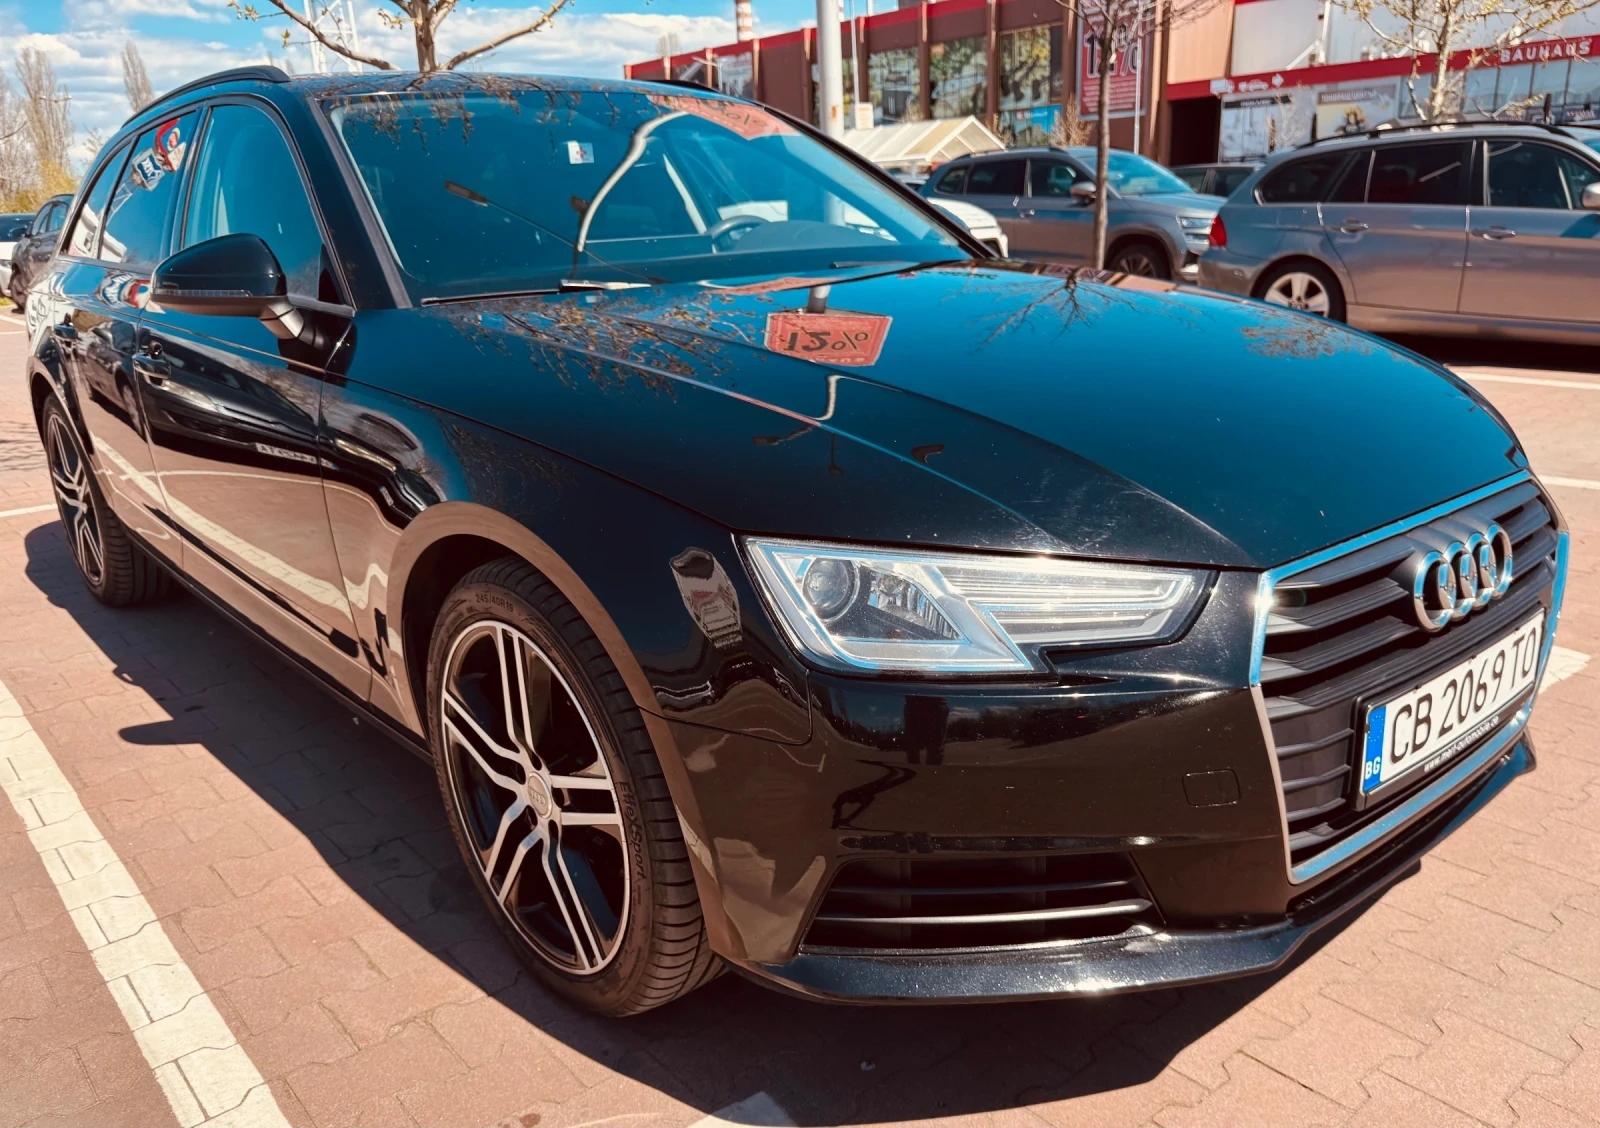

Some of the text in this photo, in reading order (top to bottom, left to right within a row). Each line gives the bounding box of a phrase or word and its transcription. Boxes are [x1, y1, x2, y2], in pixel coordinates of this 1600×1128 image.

[1501, 40, 1590, 63] BAUHAUS
[475, 593, 514, 613] 245/40R19
[1390, 627, 1537, 764] CB 2069 TO
[1364, 756, 1381, 780] BG
